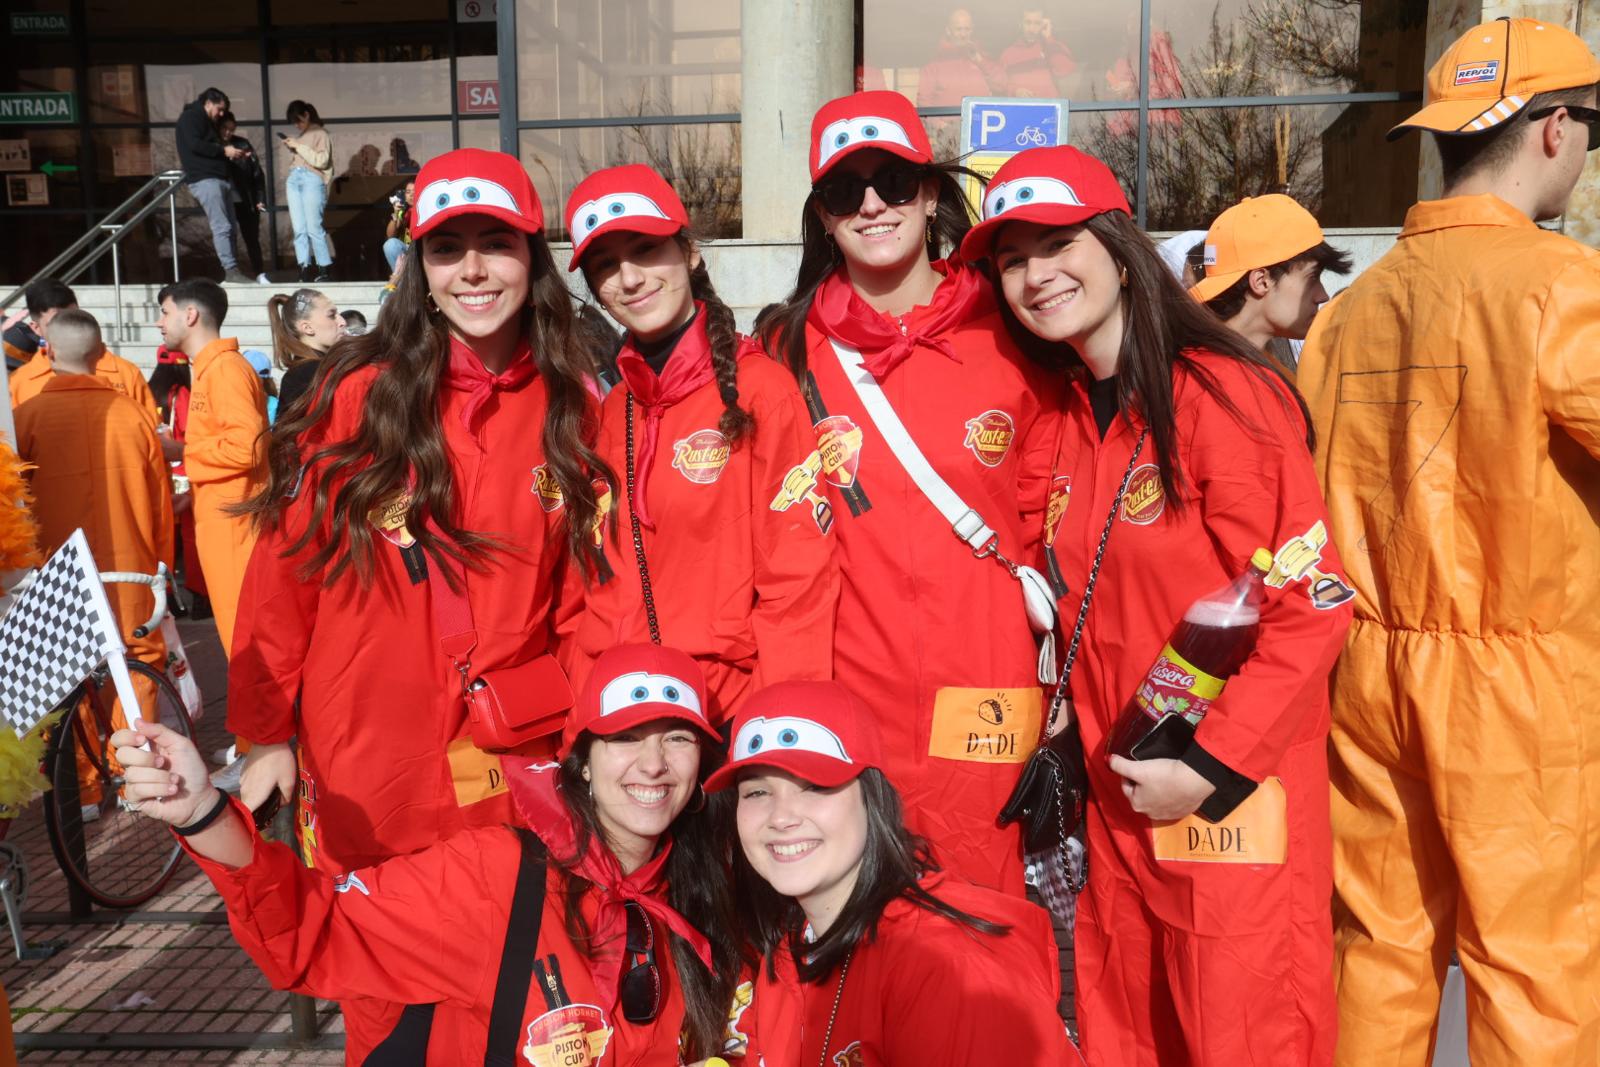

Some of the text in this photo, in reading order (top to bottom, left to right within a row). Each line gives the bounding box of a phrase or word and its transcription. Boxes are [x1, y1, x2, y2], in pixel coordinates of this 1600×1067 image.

[14, 17, 66, 29] ENTRADA
[1459, 68, 1494, 77] REPSOL
[0, 99, 69, 116] NTRADA
[980, 110, 1006, 146] P
[828, 452, 843, 467] CUP
[965, 732, 1018, 755] DADE
[1184, 826, 1248, 852] DADE
[555, 1037, 588, 1055] PISTON
[564, 1052, 585, 1066] CUP
